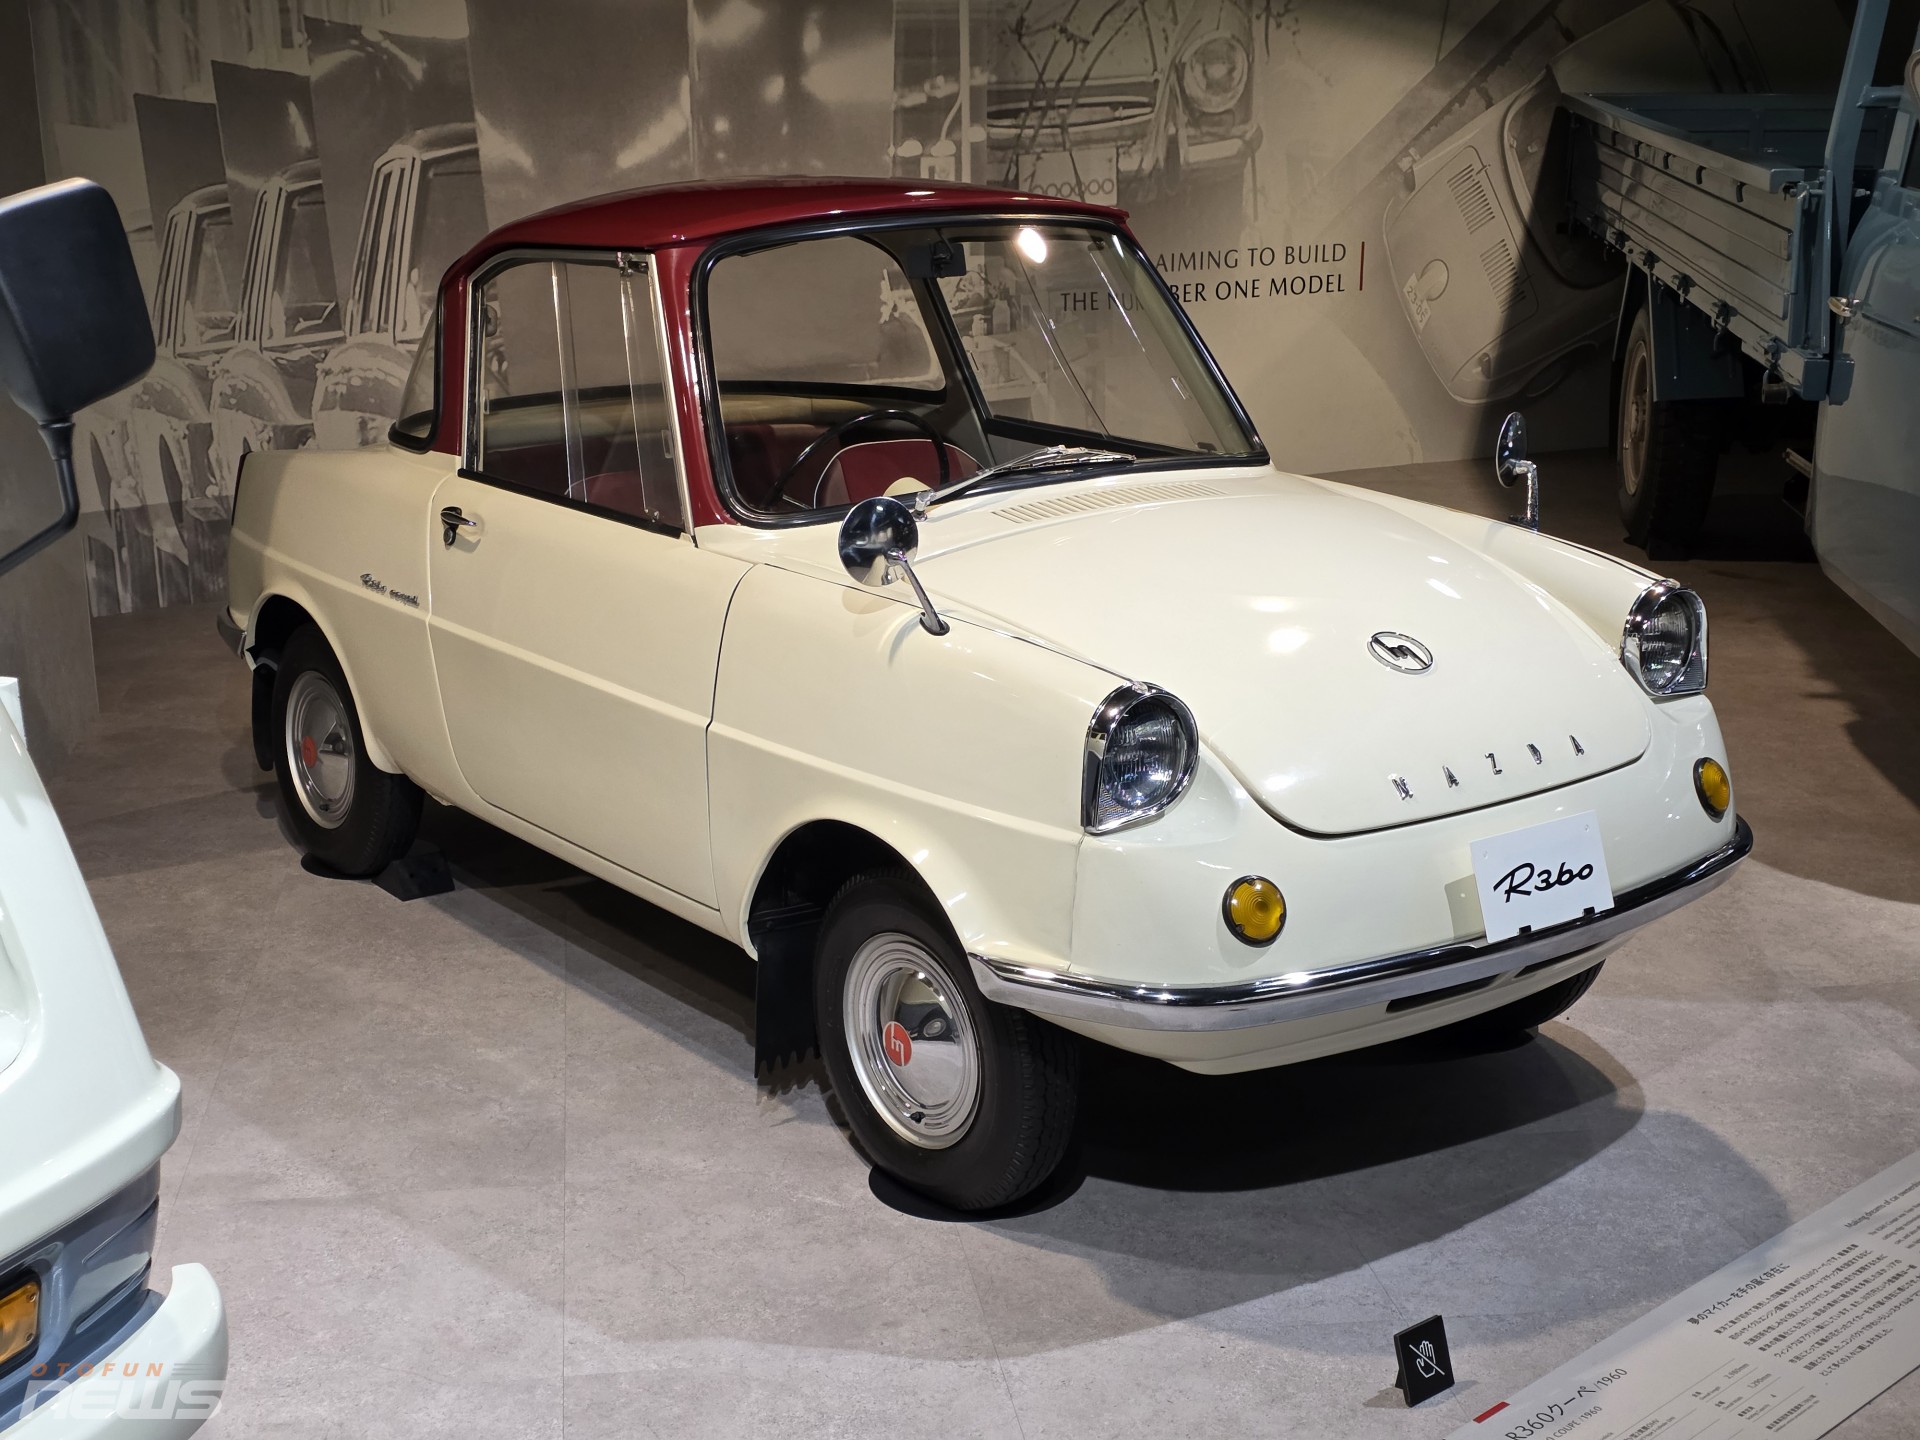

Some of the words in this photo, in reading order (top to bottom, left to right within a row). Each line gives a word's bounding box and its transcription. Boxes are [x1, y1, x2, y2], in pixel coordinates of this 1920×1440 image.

[1156, 249, 1239, 273] AIMING
[1247, 246, 1276, 267] TO
[1284, 243, 1347, 265] BUILD
[1060, 291, 1099, 311] THE
[1215, 278, 1260, 300] ONE
[1269, 273, 1345, 297] MODEL
[1391, 734, 1584, 800] MAZDA
[1493, 862, 1594, 903] R360
